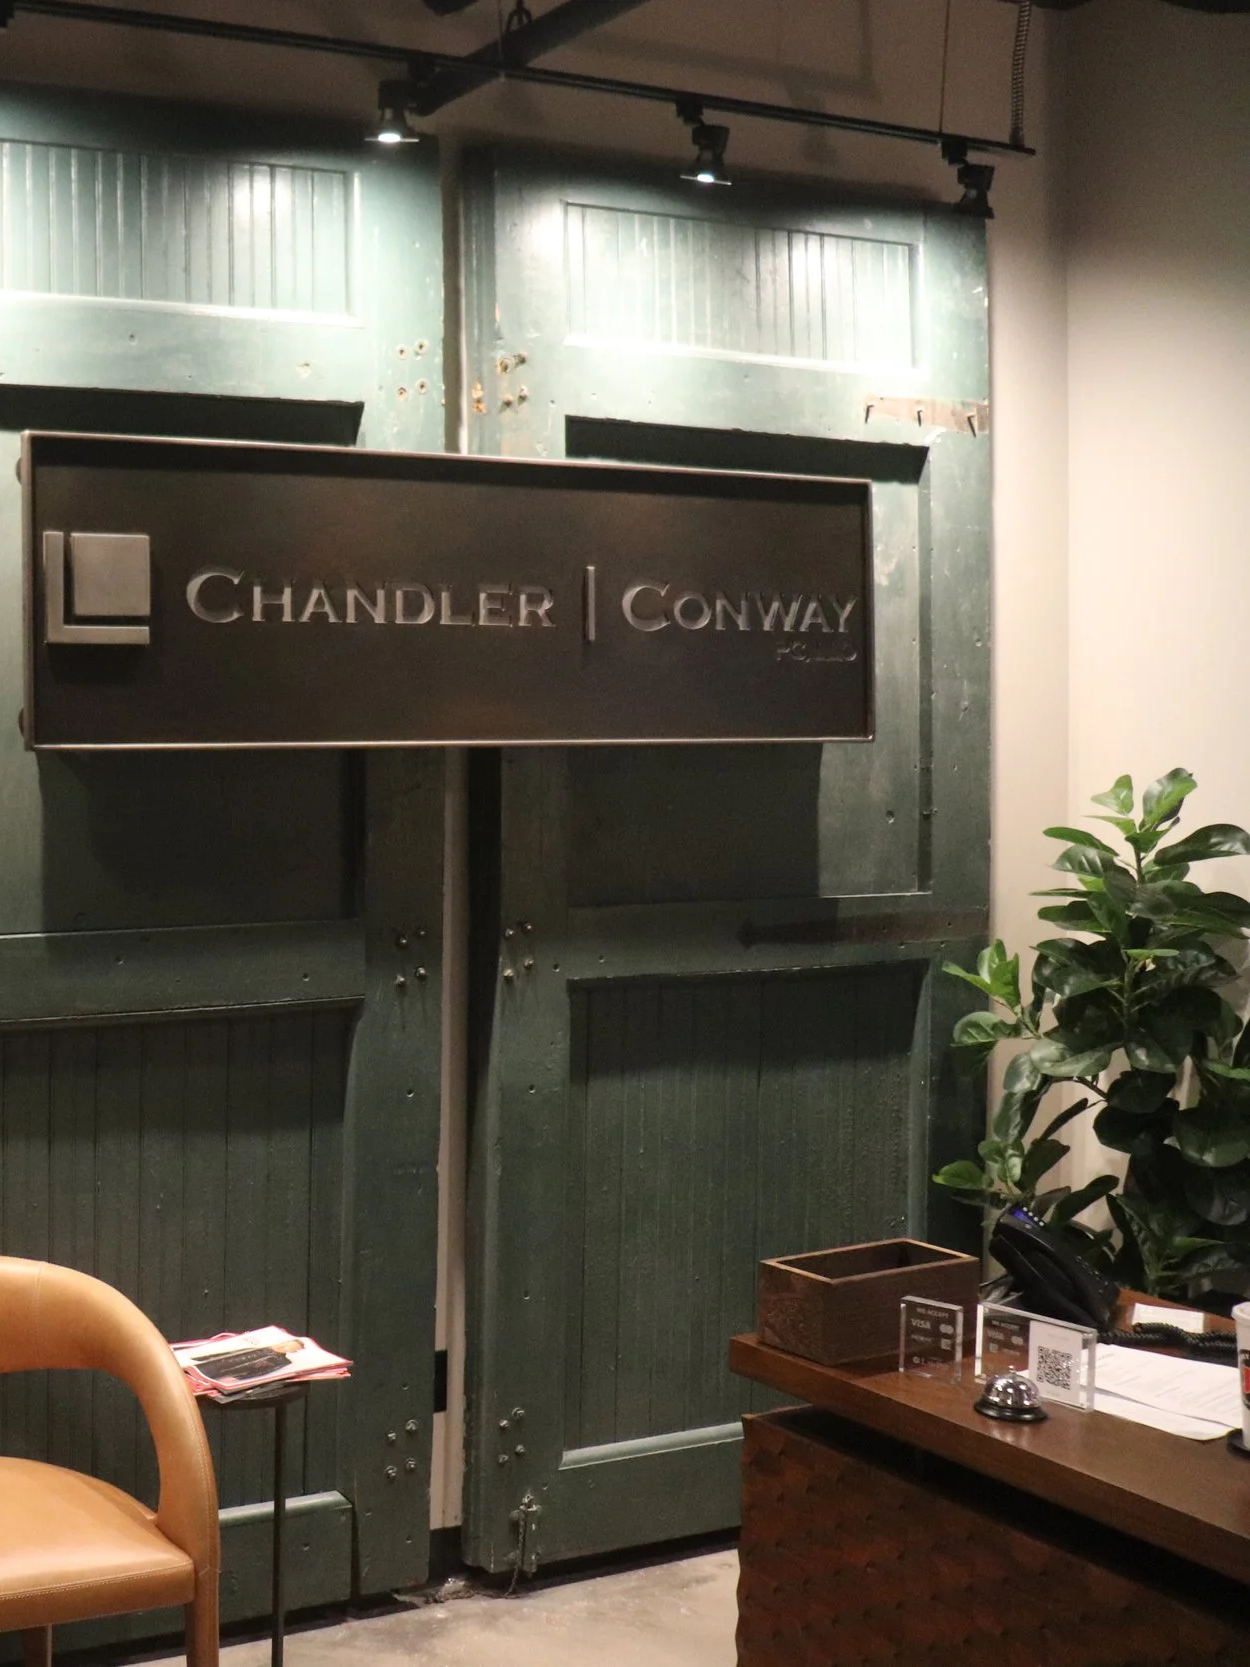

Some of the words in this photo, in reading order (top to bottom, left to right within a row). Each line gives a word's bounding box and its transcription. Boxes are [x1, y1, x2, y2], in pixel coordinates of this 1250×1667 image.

[186, 565, 556, 627] CHANDLER
[622, 578, 857, 632] CONWAY
[910, 1318, 932, 1329] VISA
